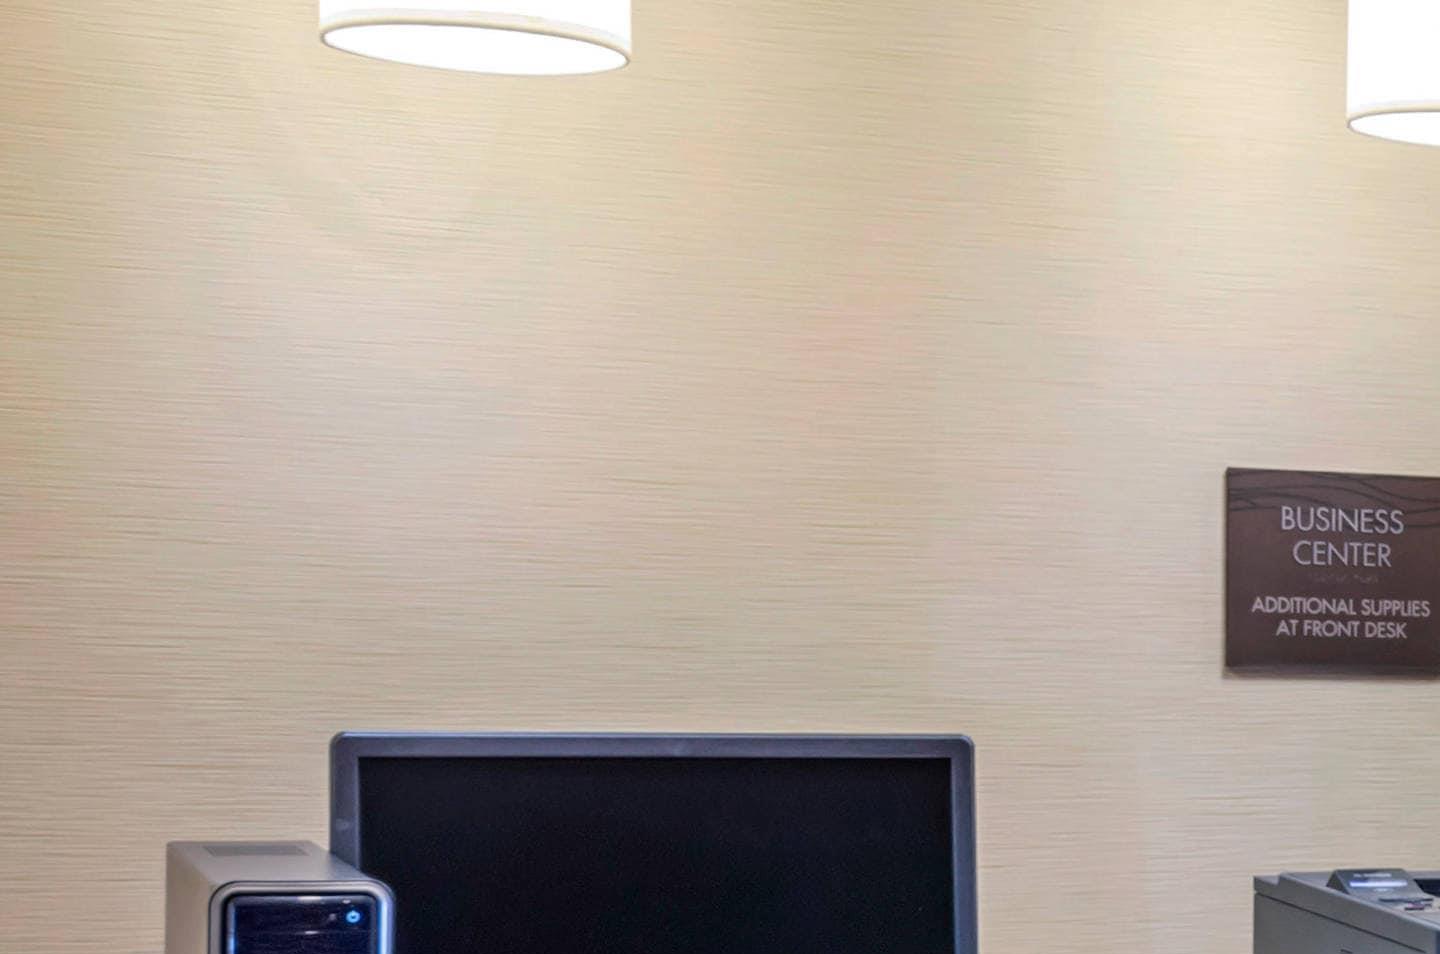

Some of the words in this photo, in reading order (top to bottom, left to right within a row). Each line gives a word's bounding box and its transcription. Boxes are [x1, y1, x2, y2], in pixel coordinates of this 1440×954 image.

[1281, 505, 1405, 535] BUSINESS
[1292, 540, 1392, 568] CENTER
[1251, 596, 1357, 616] ADDITIONAL
[1361, 599, 1431, 618] SUPPLIES
[1275, 619, 1297, 637] AT
[1303, 620, 1360, 638] FRONT
[1365, 621, 1408, 639] DESK
